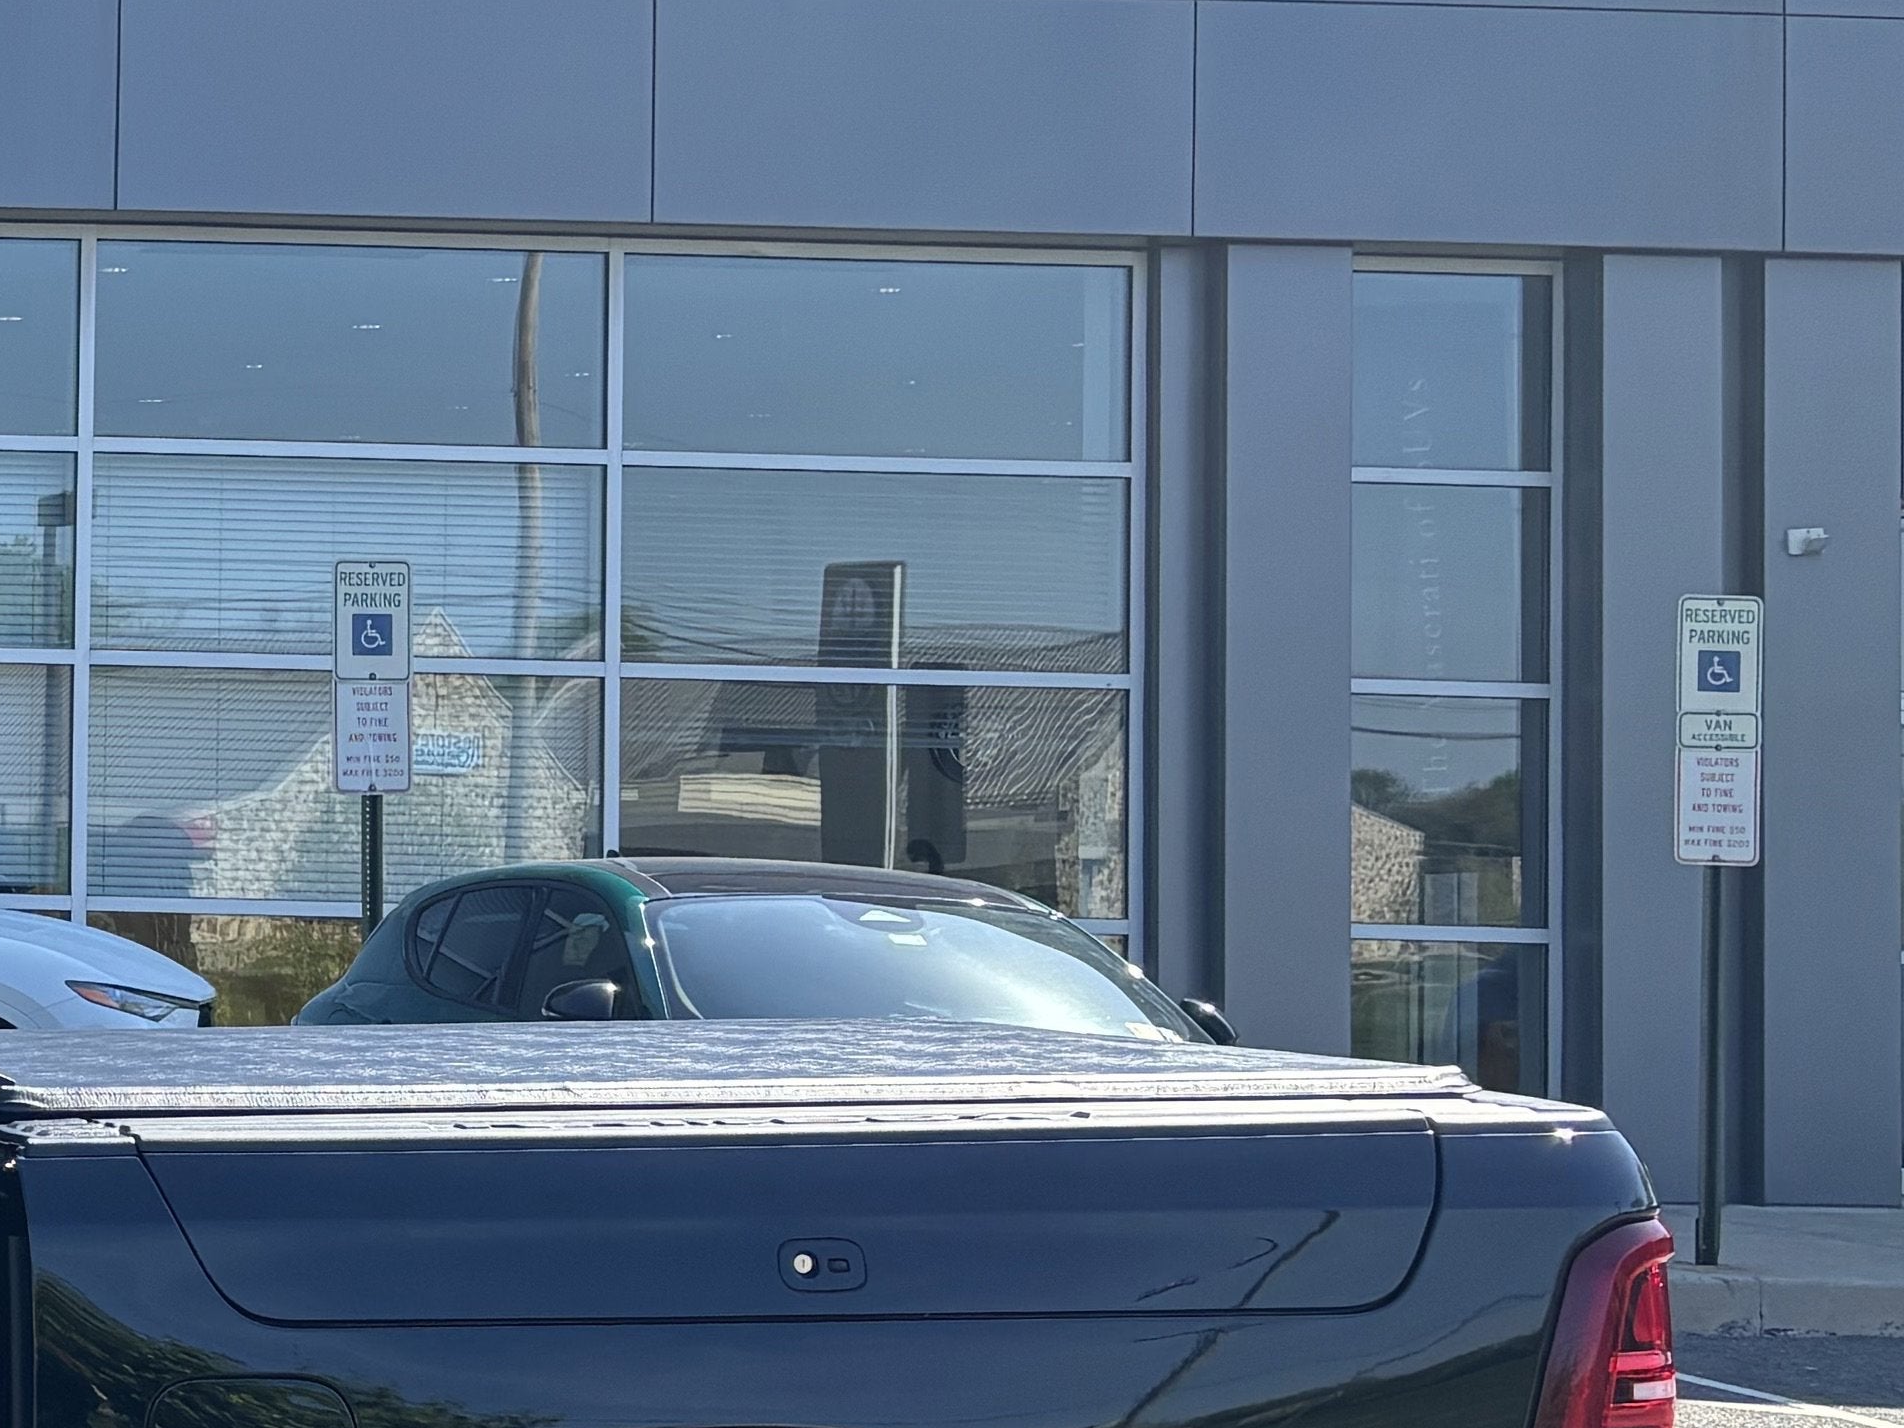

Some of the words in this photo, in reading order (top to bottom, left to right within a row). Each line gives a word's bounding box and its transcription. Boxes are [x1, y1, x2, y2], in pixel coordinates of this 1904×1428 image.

[339, 571, 406, 587] RESERVED
[343, 592, 402, 608] PARKING
[1685, 608, 1755, 625] RESERVED
[1688, 628, 1751, 645] PARKING
[1704, 718, 1733, 732] VAN
[1701, 787, 1712, 798] TO
